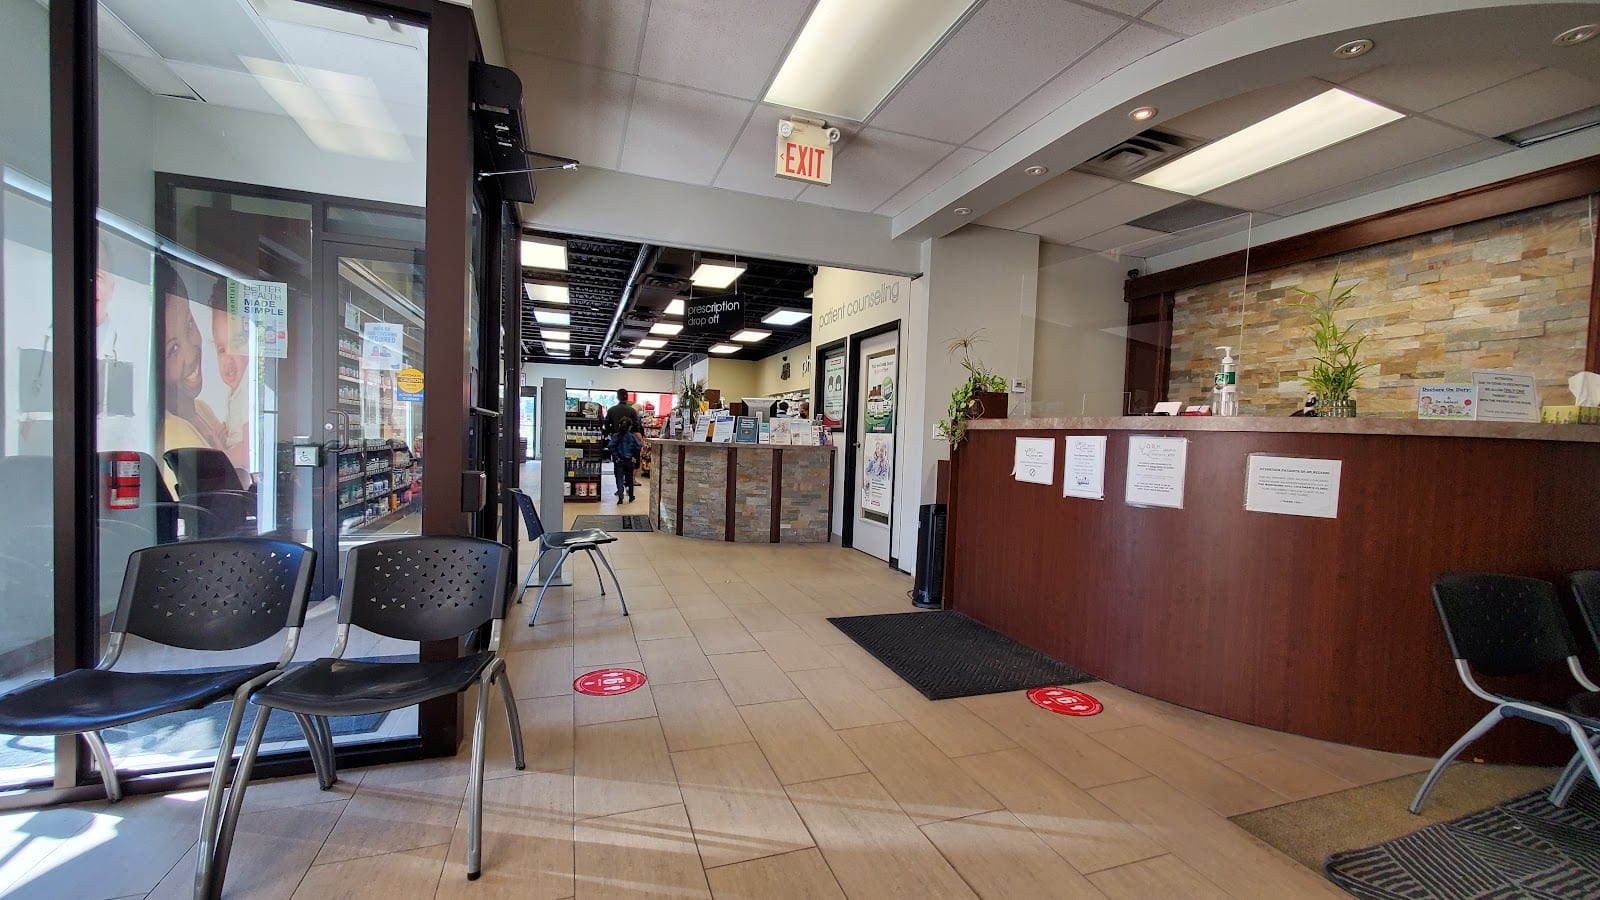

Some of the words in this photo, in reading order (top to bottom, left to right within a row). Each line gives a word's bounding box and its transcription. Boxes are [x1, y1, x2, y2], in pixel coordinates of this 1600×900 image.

[785, 142, 825, 179] EXIT
[243, 284, 282, 294] BETTER
[243, 291, 282, 301] HEALTH
[244, 298, 276, 308] MADE
[687, 300, 740, 317] prescription
[244, 306, 285, 316] SIMPLE
[818, 302, 846, 332] patient
[687, 316, 707, 327] drop
[707, 313, 720, 325] off
